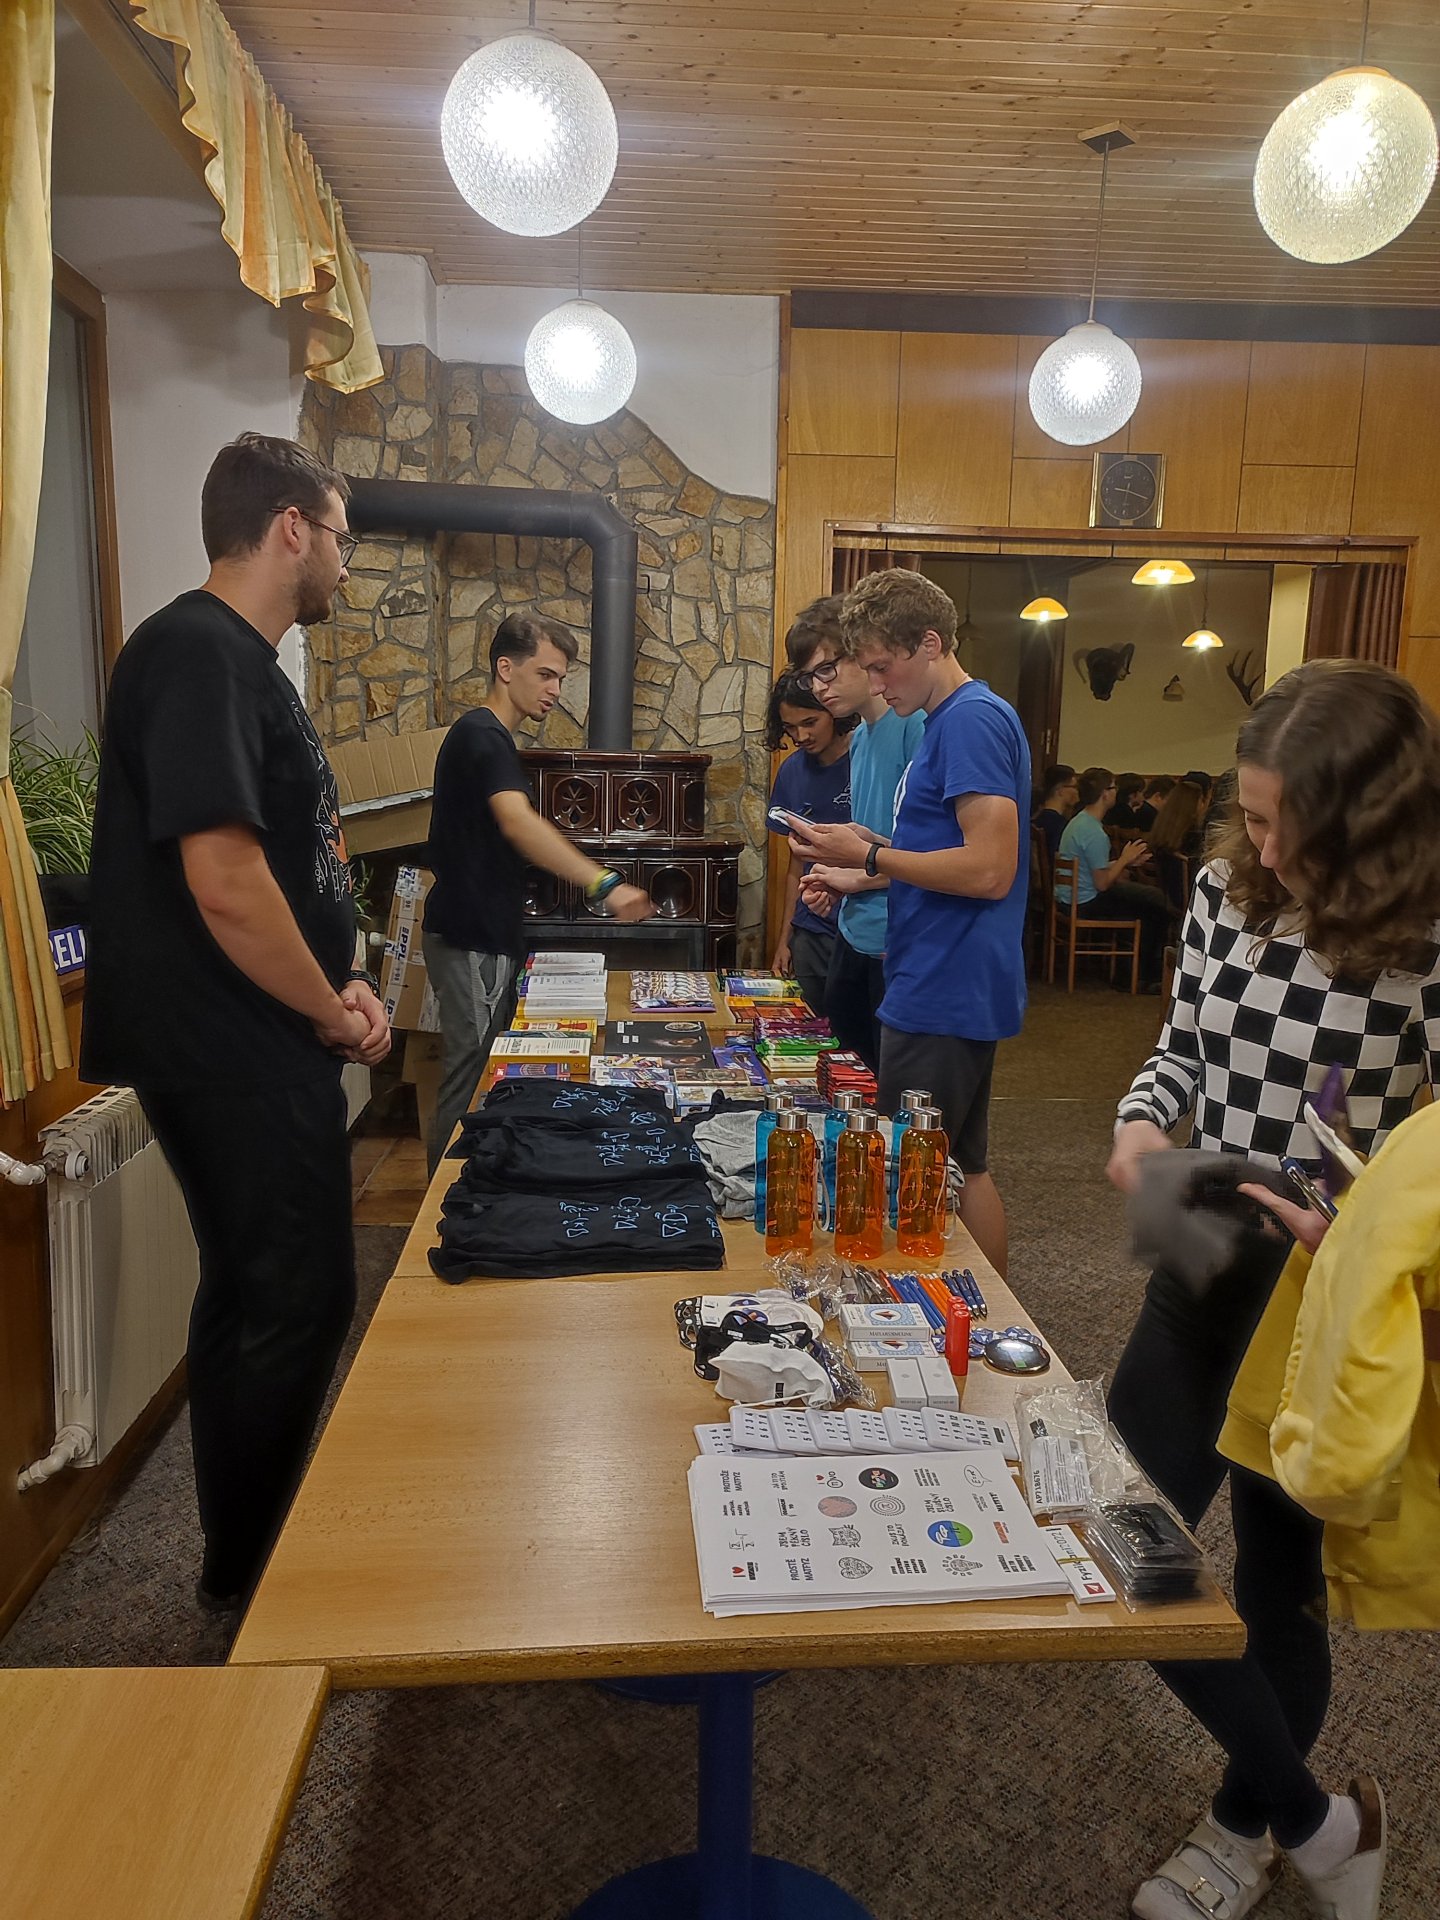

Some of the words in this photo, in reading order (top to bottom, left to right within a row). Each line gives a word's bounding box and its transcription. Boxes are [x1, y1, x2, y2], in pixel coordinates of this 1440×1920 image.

[397, 933, 409, 961] PPL
[787, 1557, 799, 1581] PROSTĚ
[801, 1557, 814, 1581] MATFYZ
